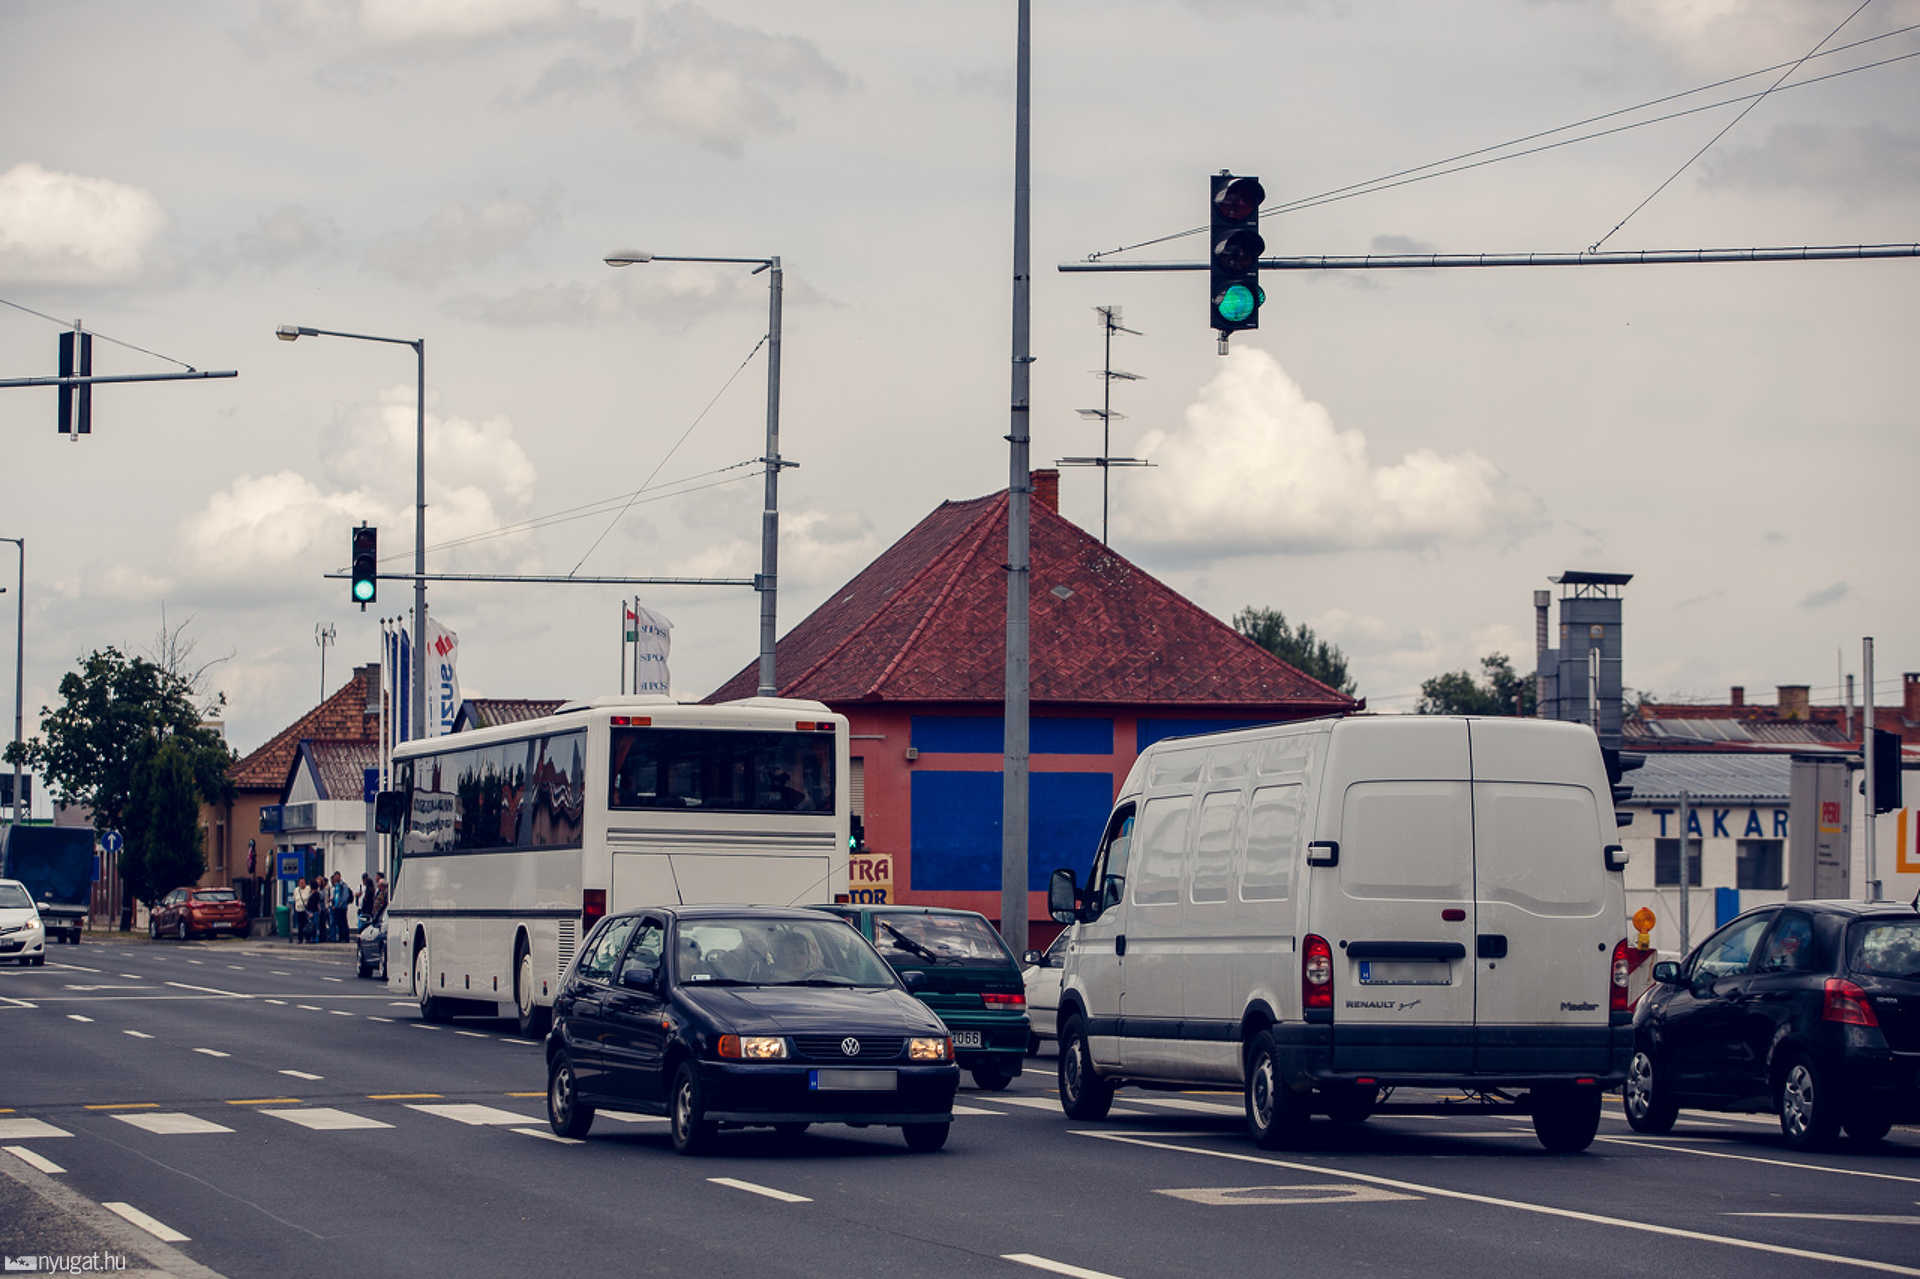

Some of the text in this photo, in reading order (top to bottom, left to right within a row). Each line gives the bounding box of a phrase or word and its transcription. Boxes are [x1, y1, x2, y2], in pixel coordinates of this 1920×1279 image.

[1652, 807, 1789, 838] TAKAR
[849, 859, 889, 882] TRA
[1345, 1000, 1396, 1009] RENAULT
